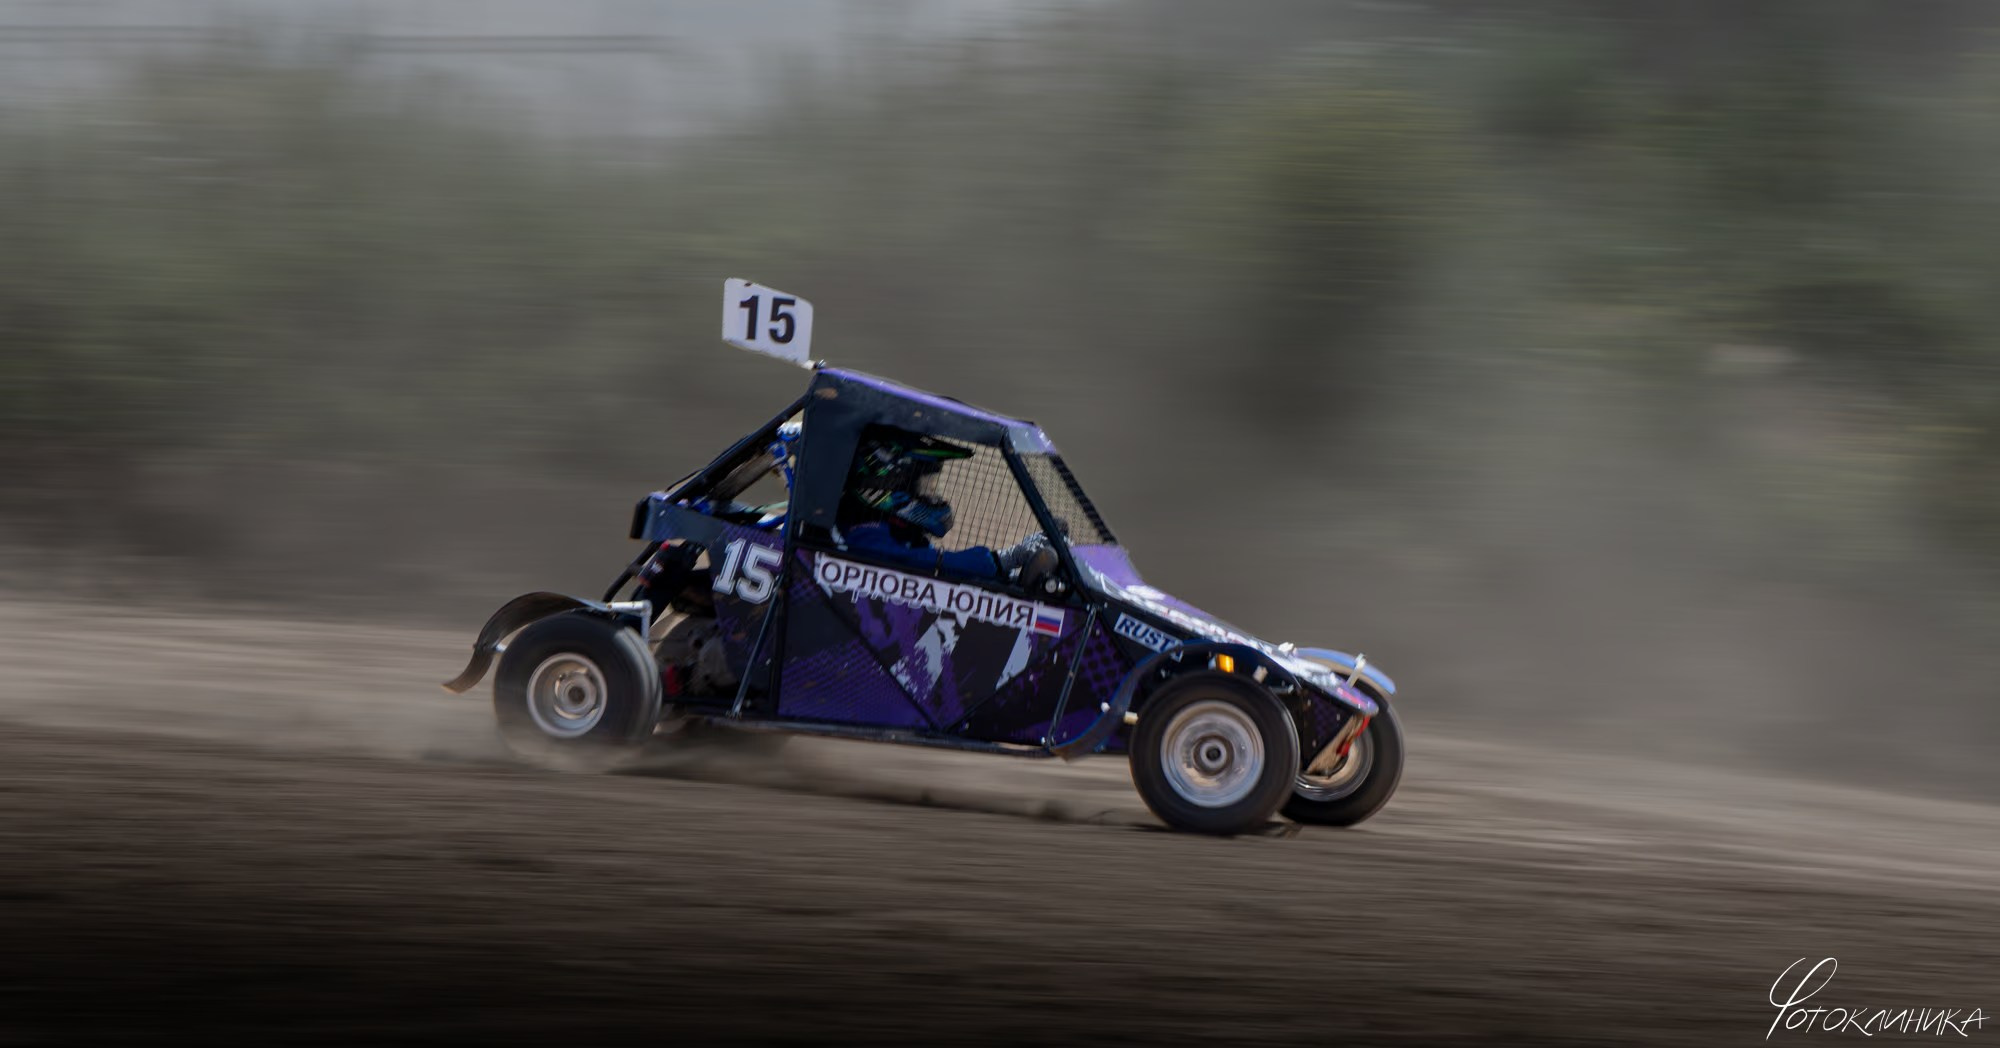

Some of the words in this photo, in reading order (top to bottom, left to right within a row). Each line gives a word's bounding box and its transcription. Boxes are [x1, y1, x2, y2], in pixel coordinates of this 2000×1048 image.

[739, 295, 796, 344] 15
[712, 537, 783, 604] 15
[821, 561, 936, 605] ОРЛОВА
[946, 588, 1034, 627] ЮЛИЯ
[1117, 617, 1183, 658] RUST
